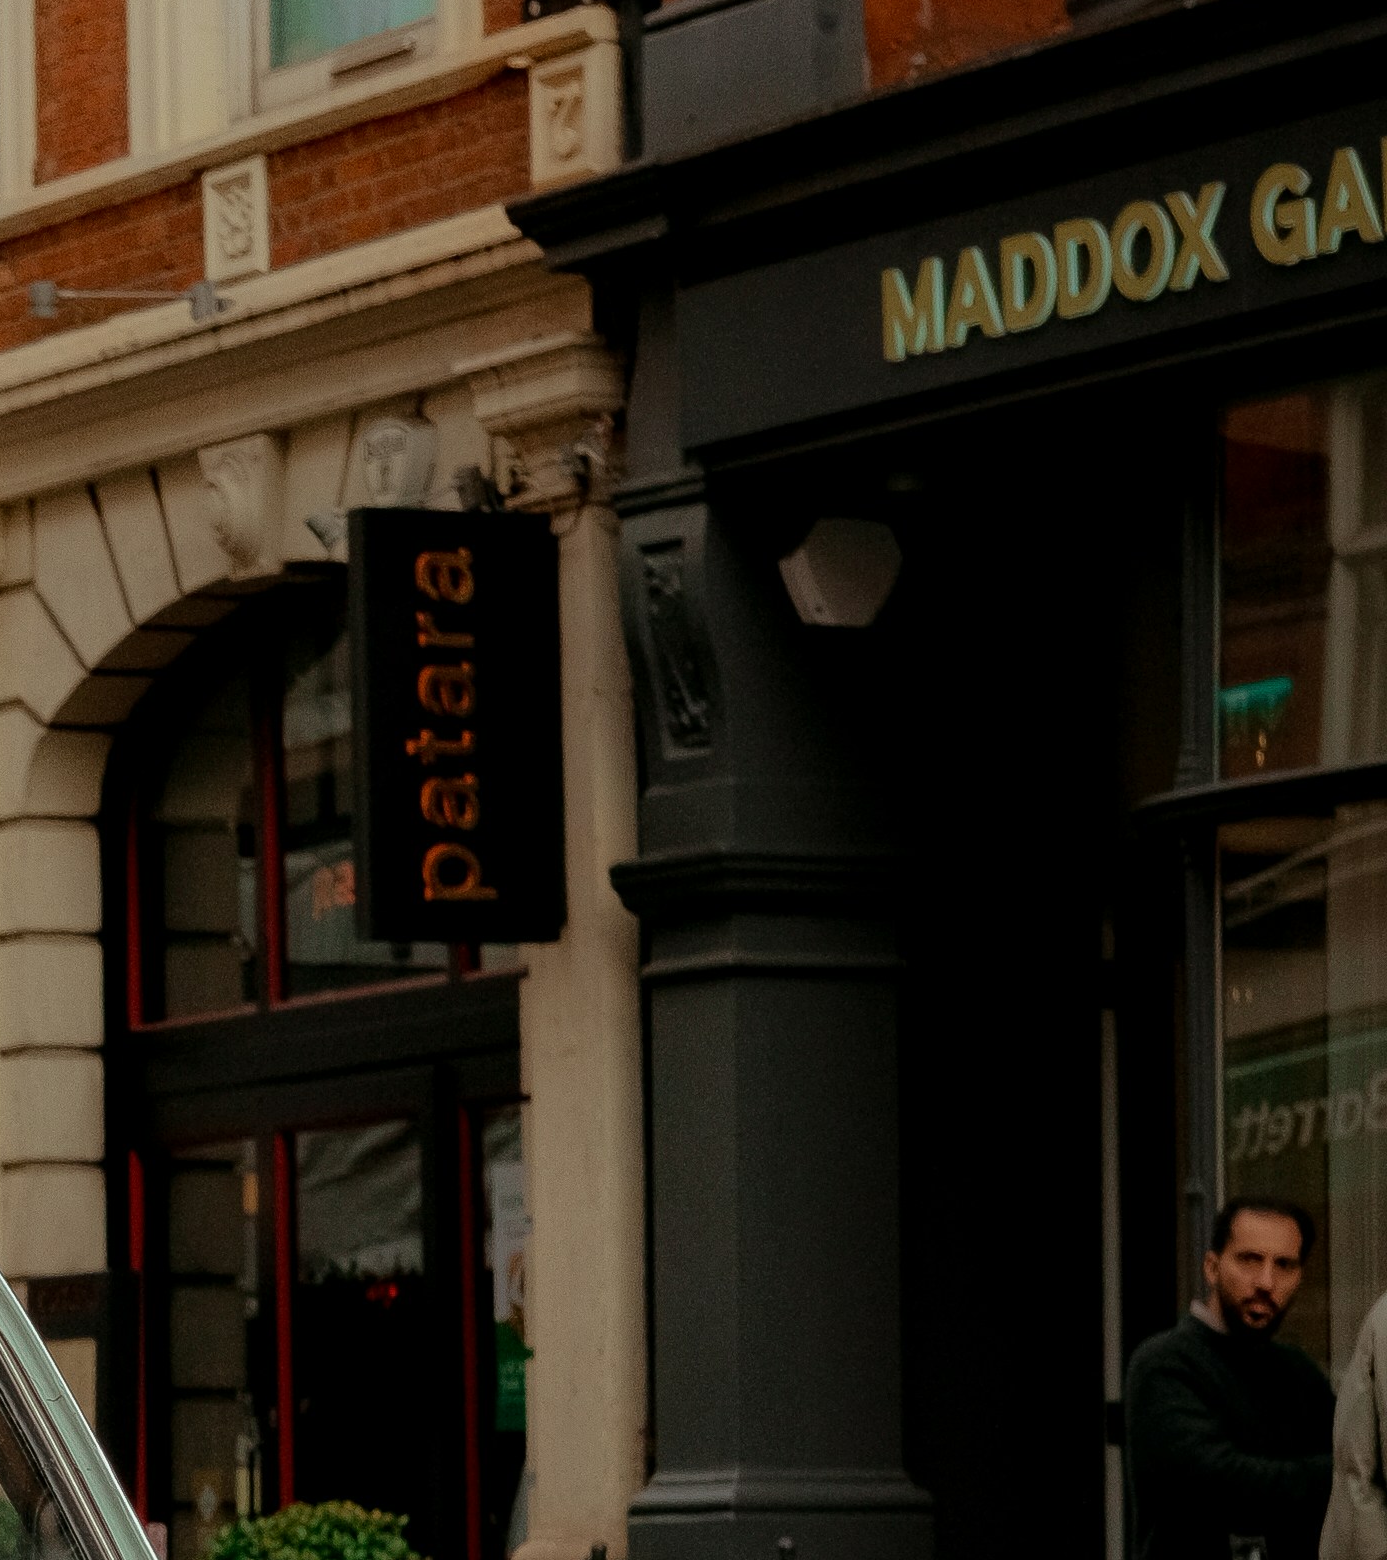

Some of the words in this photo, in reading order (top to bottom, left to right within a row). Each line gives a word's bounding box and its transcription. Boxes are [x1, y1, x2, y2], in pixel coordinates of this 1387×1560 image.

[881, 181, 1229, 363] MADDOX
[1250, 136, 1387, 267] GA
[406, 547, 498, 901] patara
